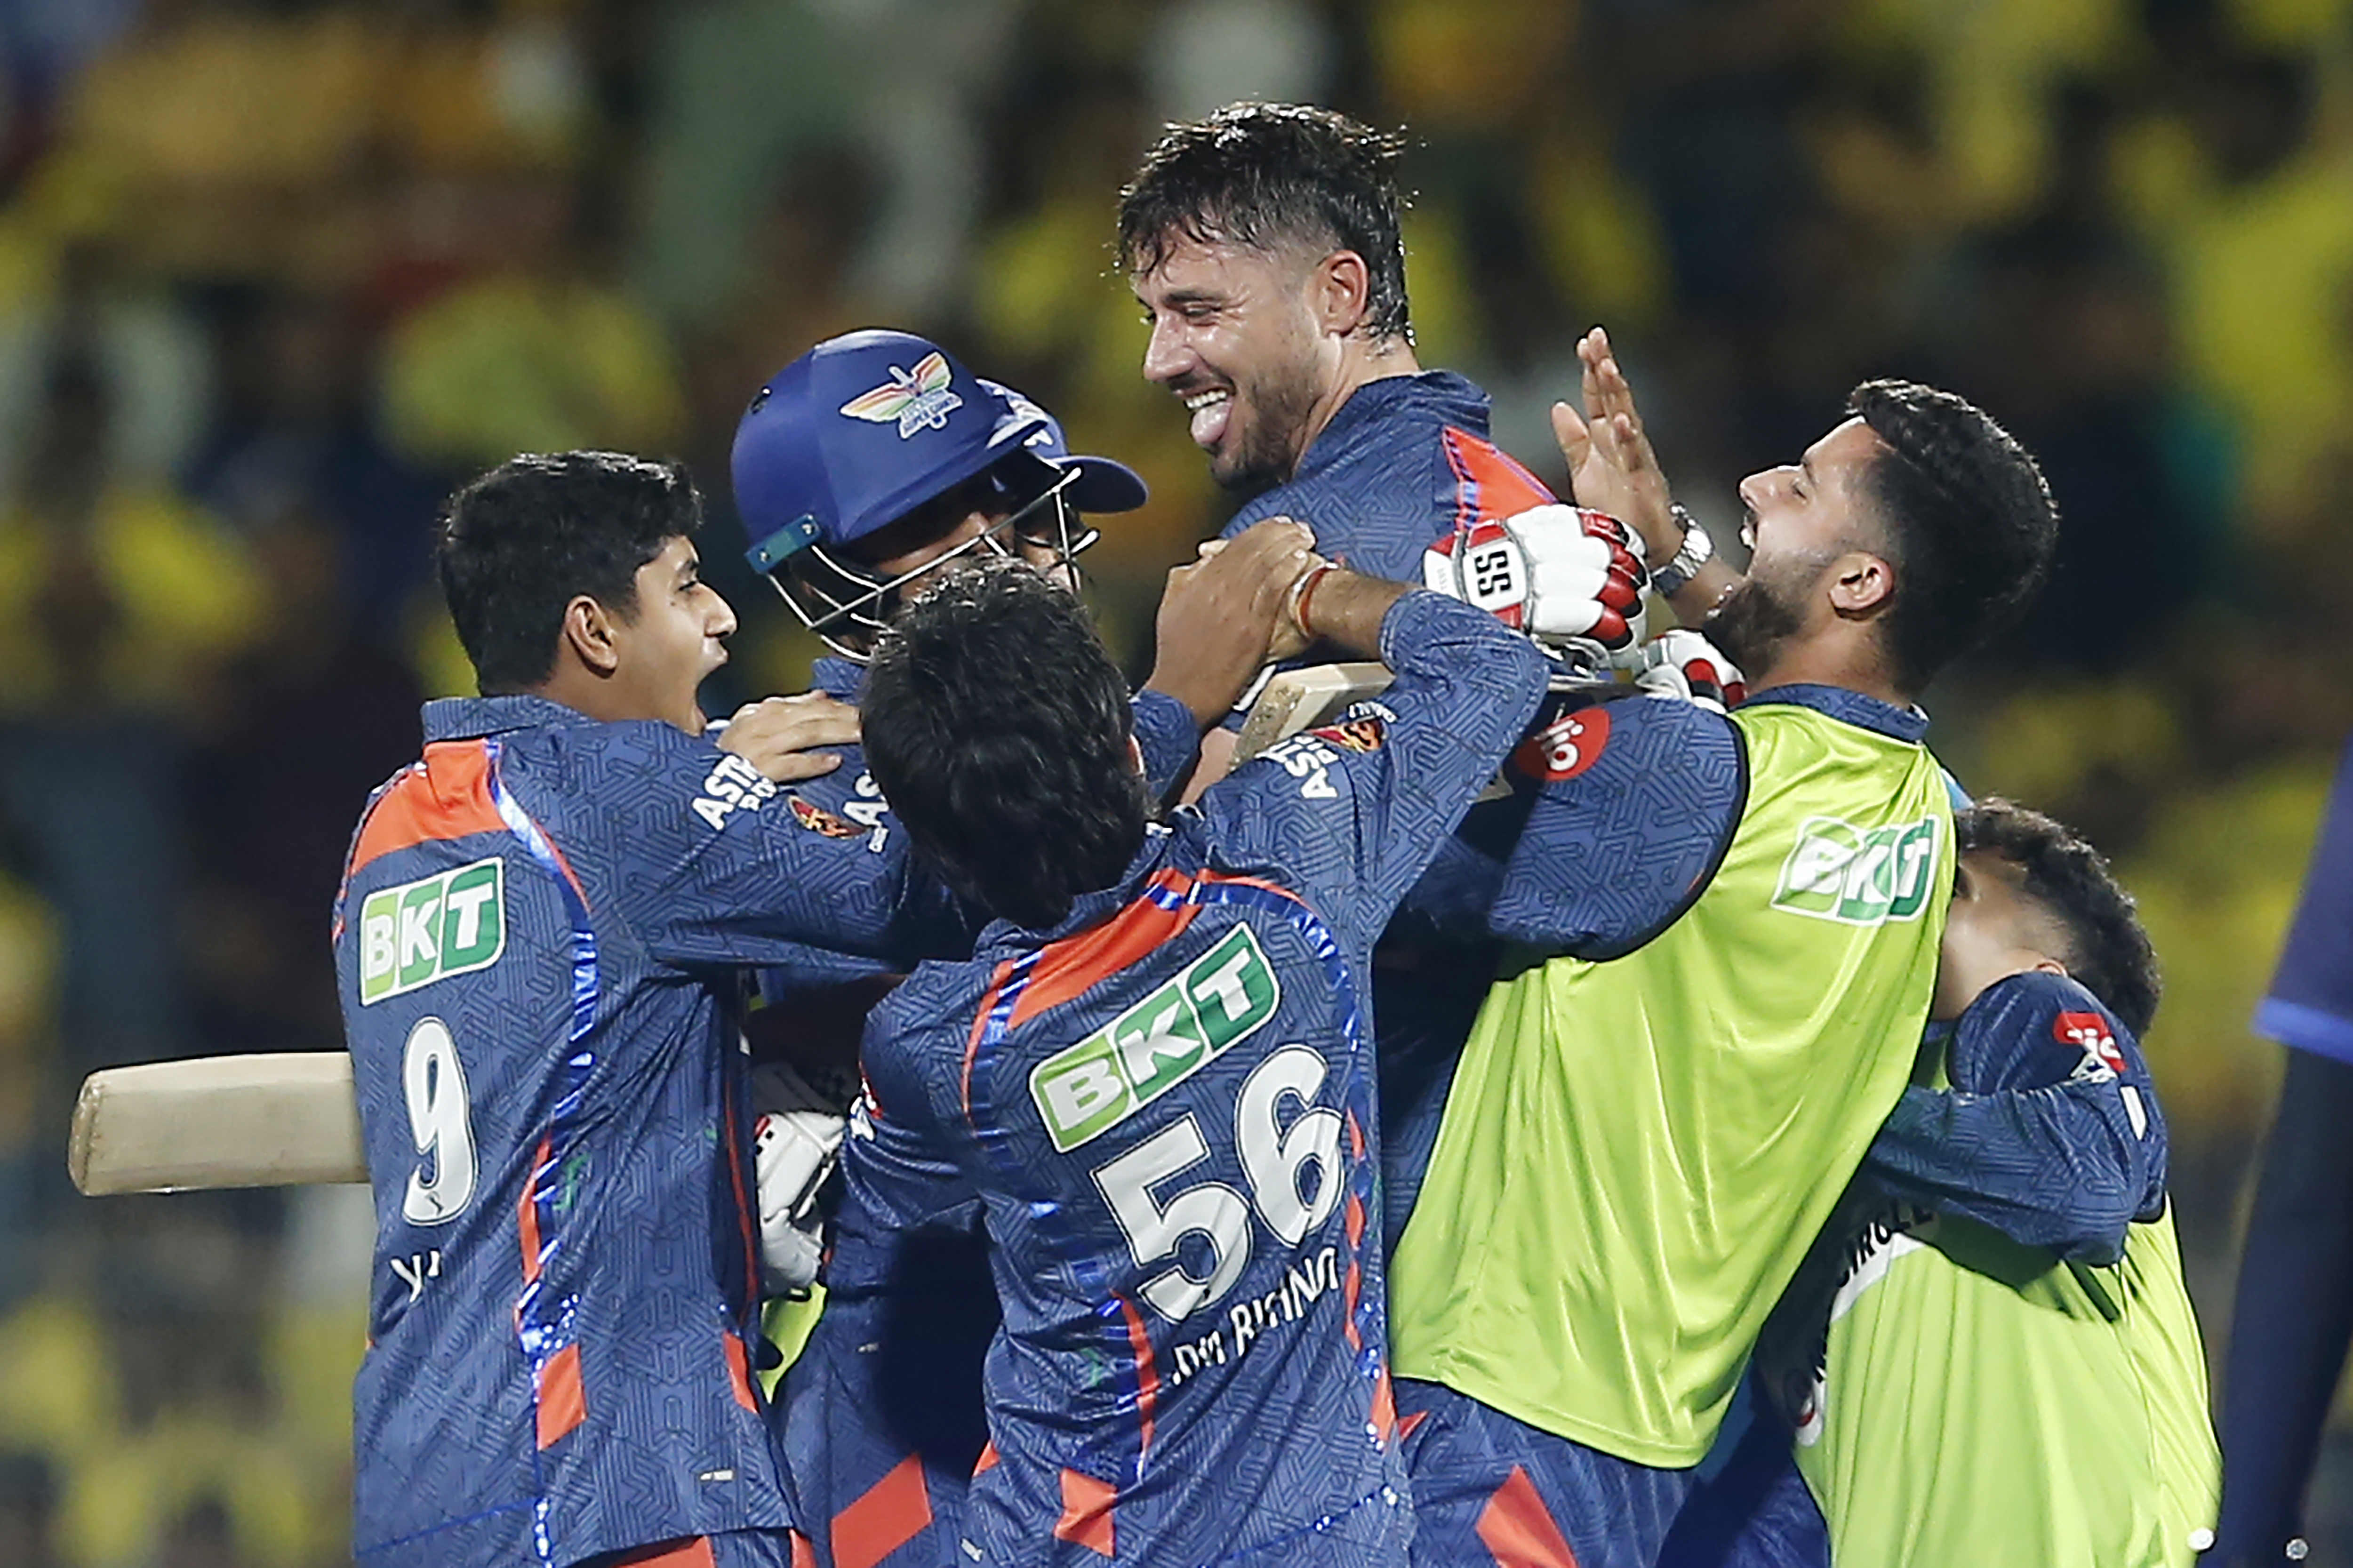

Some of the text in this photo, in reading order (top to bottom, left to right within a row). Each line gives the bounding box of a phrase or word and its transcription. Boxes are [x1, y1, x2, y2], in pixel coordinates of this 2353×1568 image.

[1474, 550, 1513, 598] SS
[364, 883, 495, 982] BKT
[1789, 835, 1930, 903] BKT
[1042, 946, 1254, 1133] BKT
[400, 1016, 479, 1225] 9
[1089, 1043, 1345, 1324] 56
